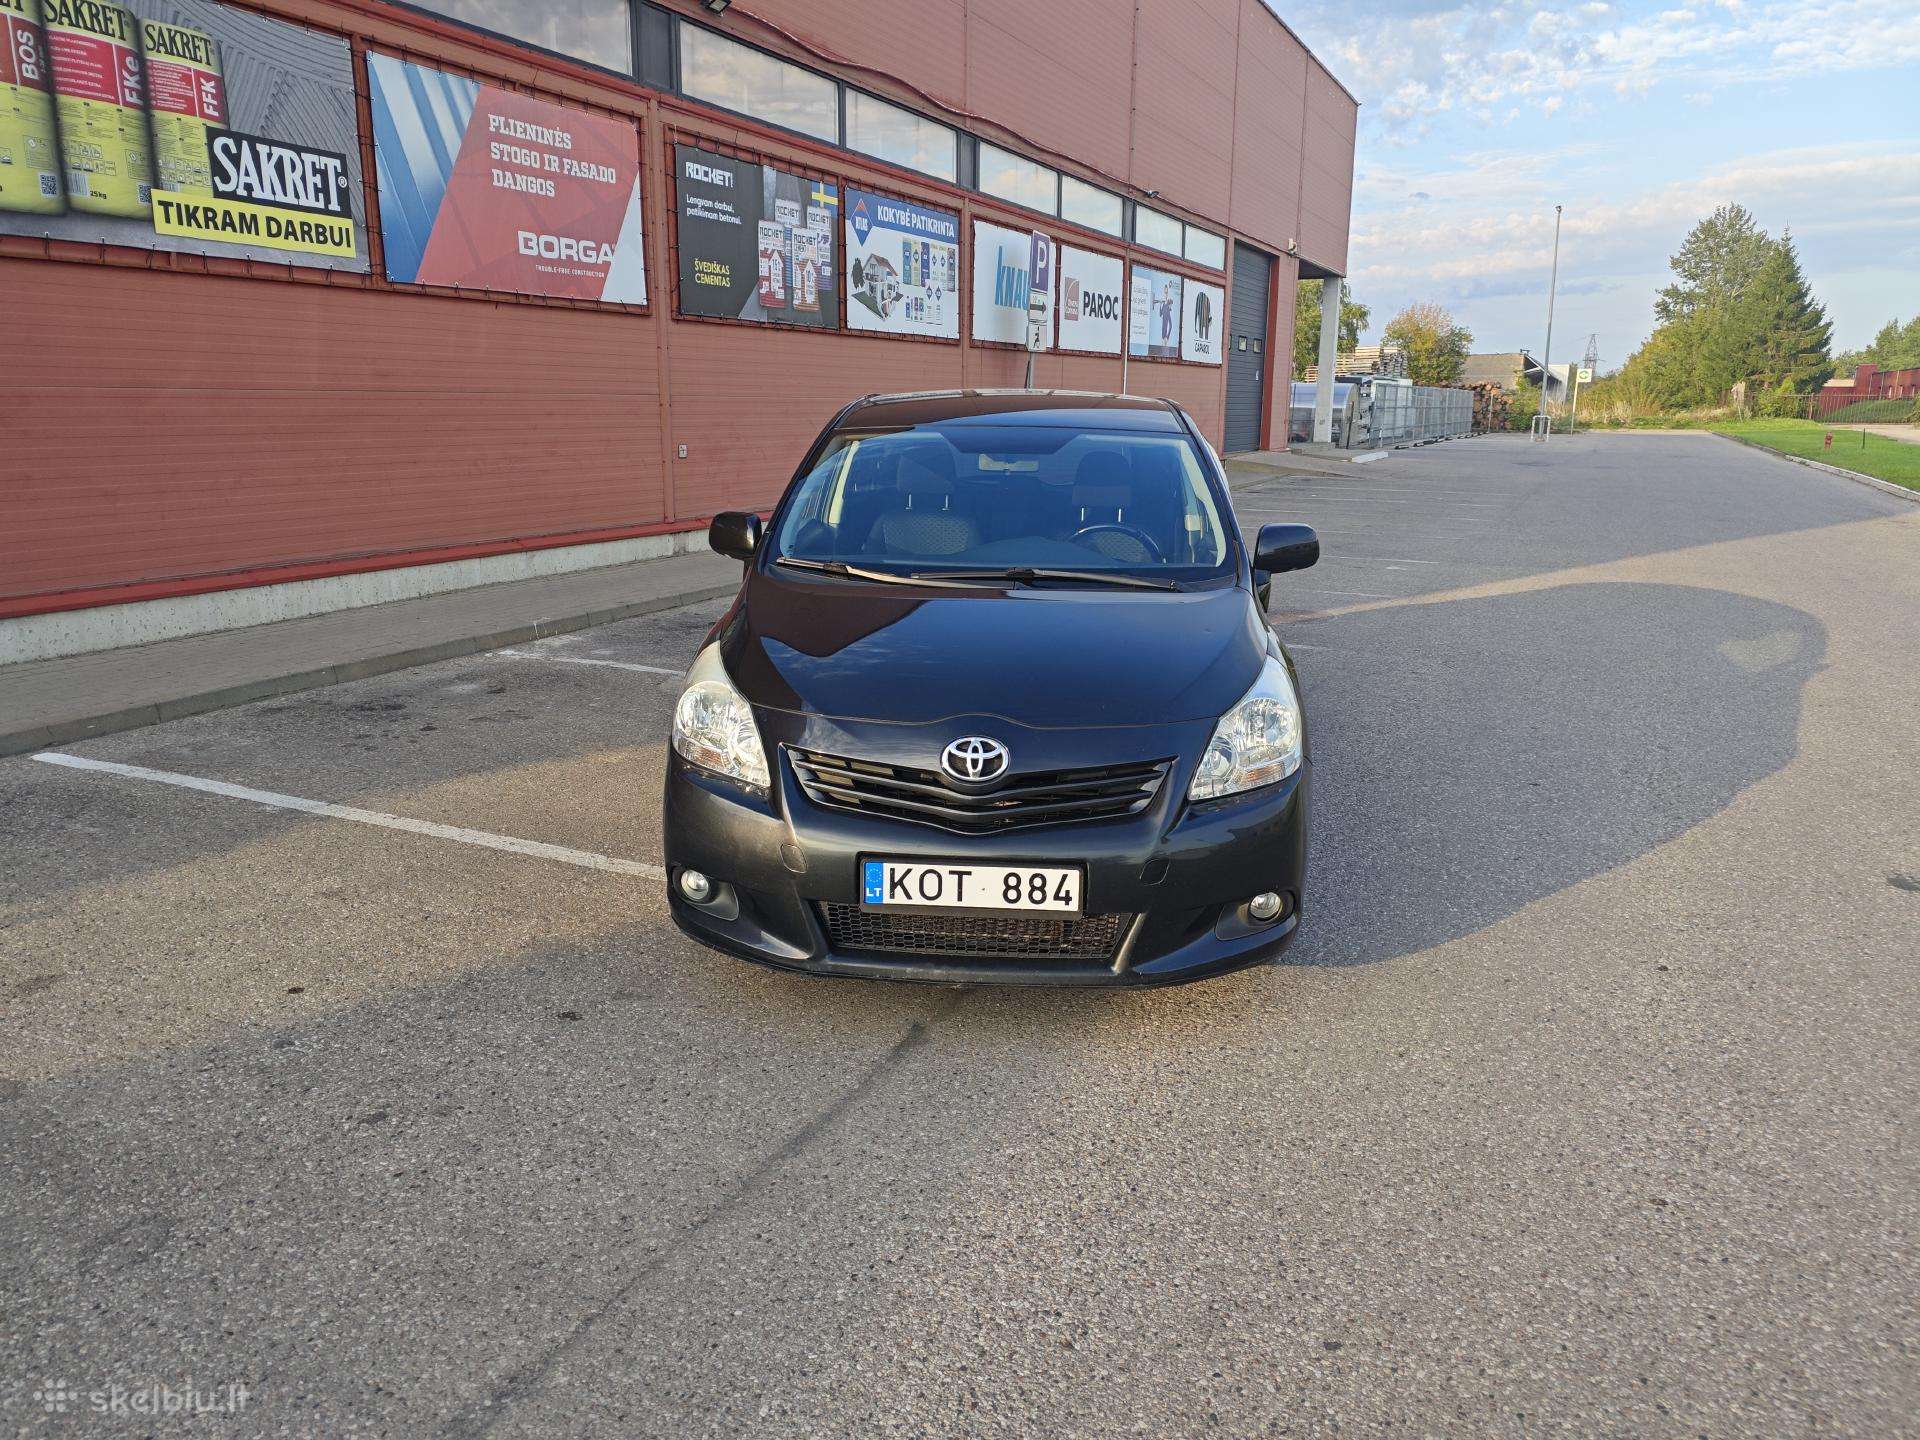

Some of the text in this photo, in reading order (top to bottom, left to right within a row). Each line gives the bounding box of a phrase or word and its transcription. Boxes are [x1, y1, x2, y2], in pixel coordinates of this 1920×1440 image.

[17, 29, 39, 80] BOS
[145, 24, 212, 66] SAKRET
[488, 113, 572, 150] PLIENINĖS
[490, 141, 616, 184] STOGO IR FASADO
[491, 168, 555, 197] DANGOS
[158, 200, 351, 248] TIKRAM DARBUI
[877, 205, 955, 238] KOKYBĖ PATIKRINTA
[517, 230, 614, 264] BORGA
[1036, 240, 1047, 284] P
[694, 258, 730, 275] ŠVEDIŠKAS
[695, 273, 731, 288] CEMENTAS
[994, 245, 1030, 311] KNAU
[1083, 290, 1118, 321] PAROC
[866, 887, 881, 897] LT
[889, 868, 1073, 906] KOT 884
